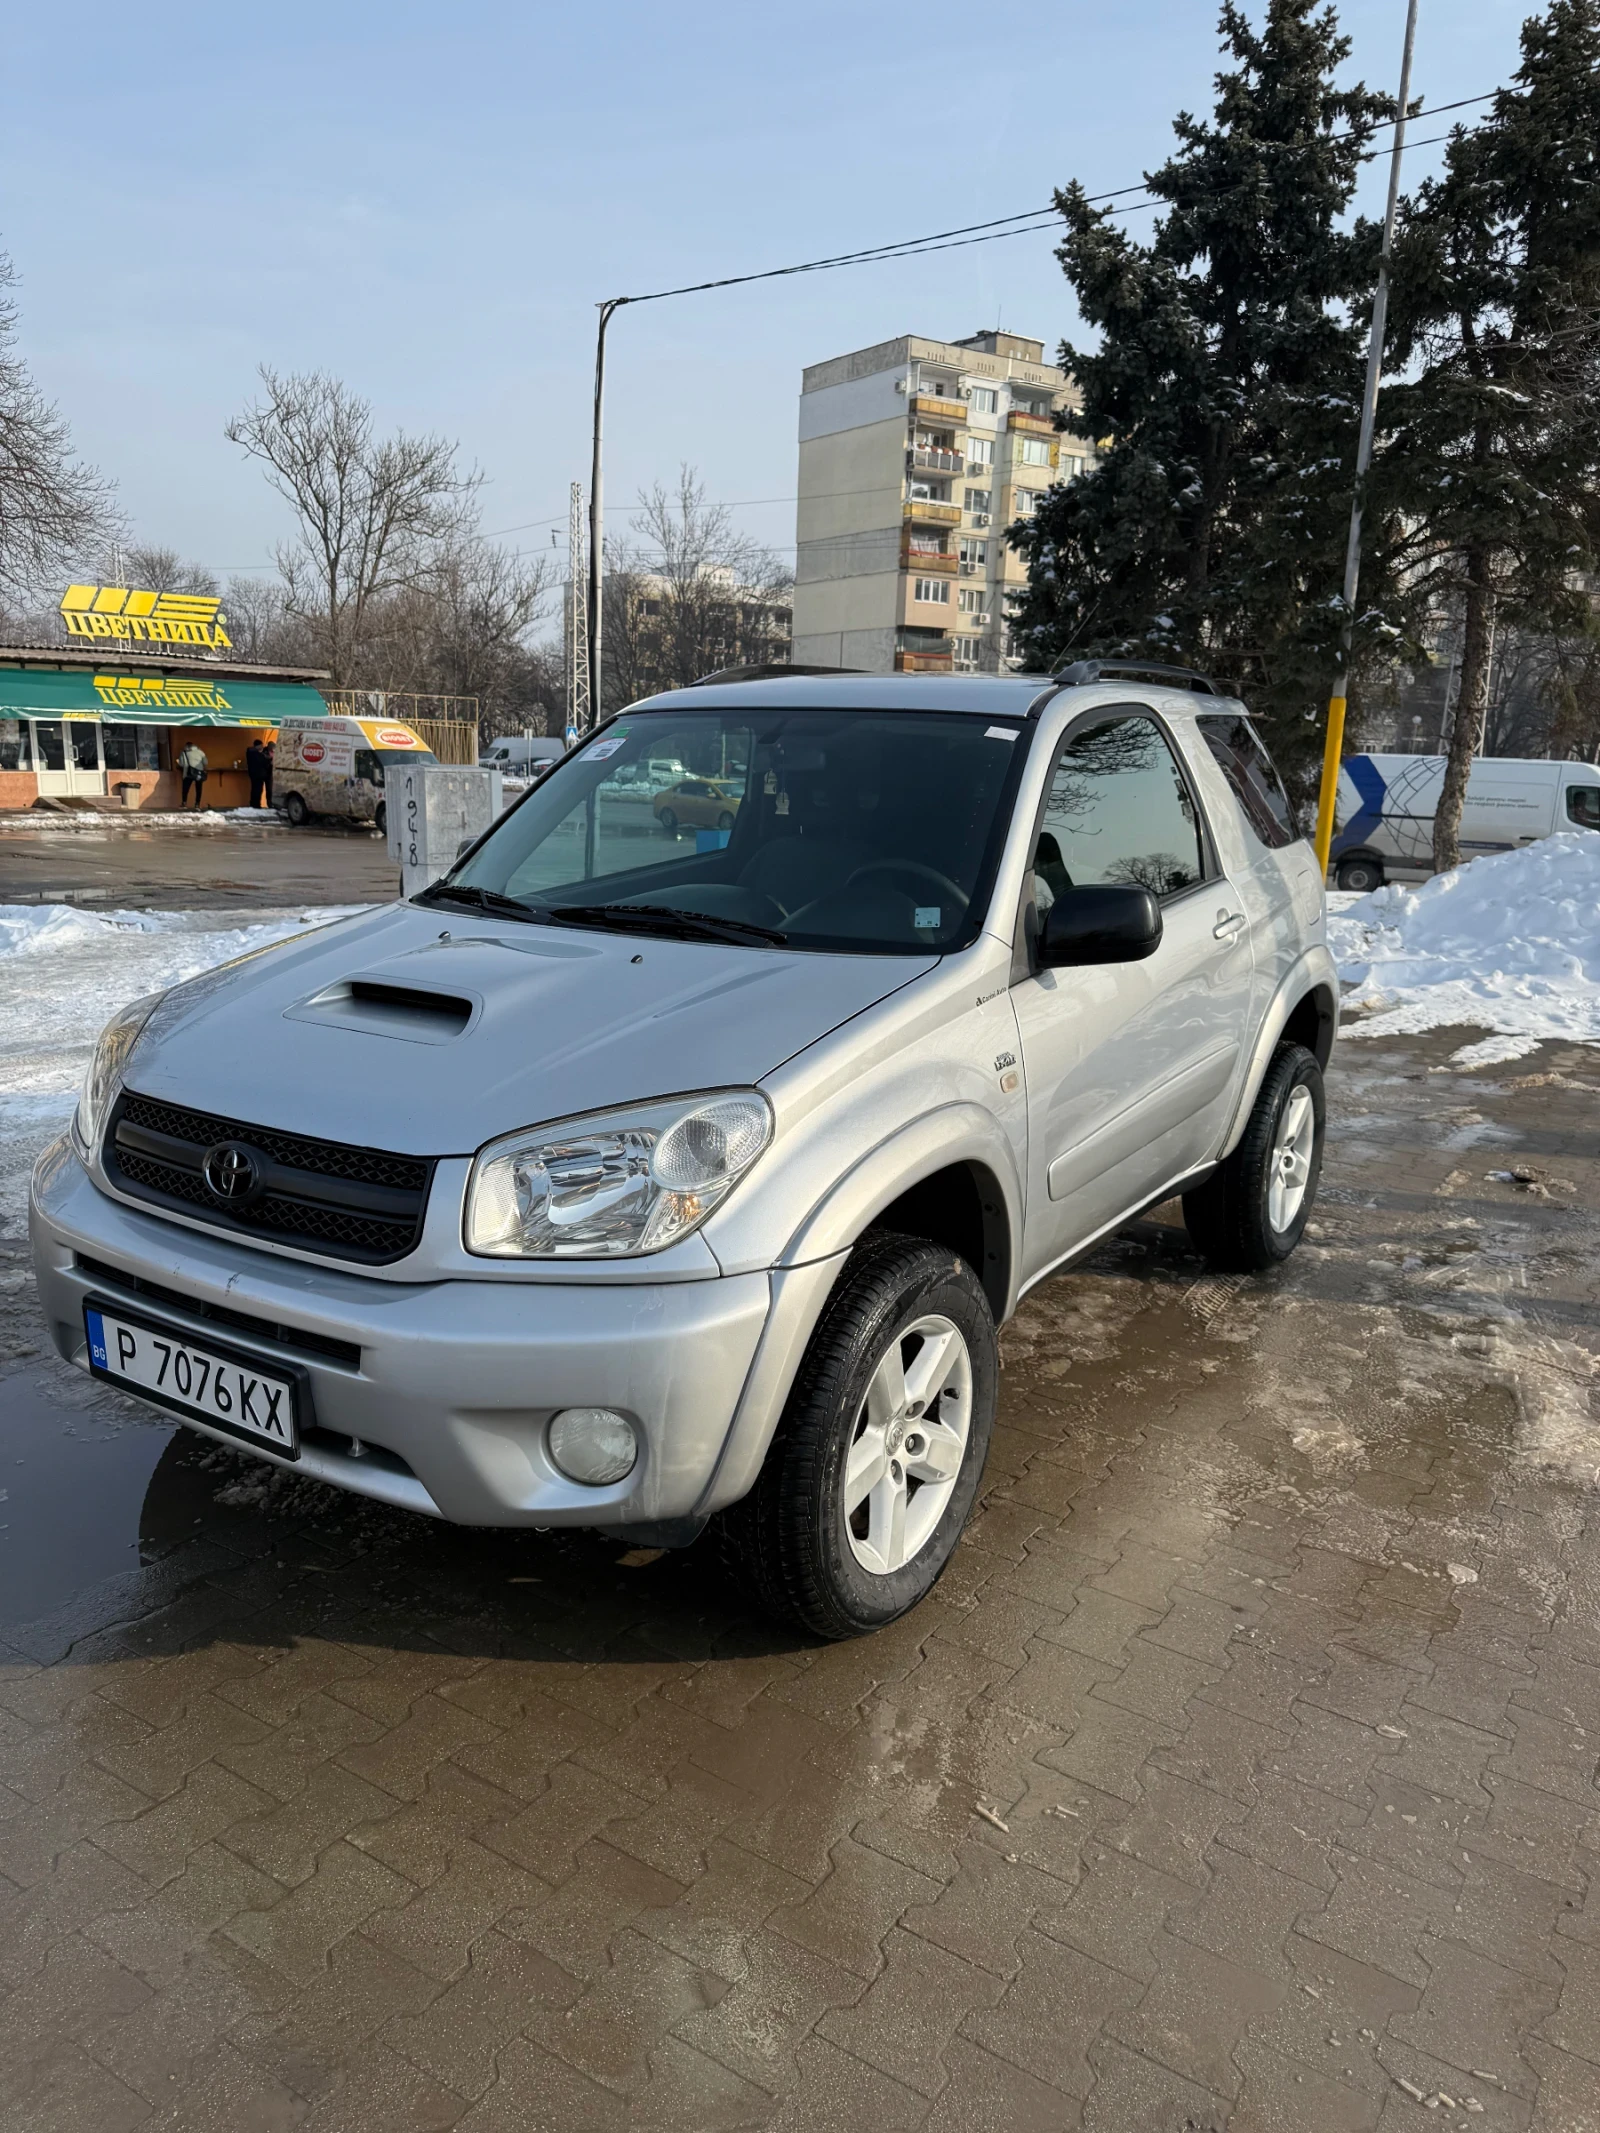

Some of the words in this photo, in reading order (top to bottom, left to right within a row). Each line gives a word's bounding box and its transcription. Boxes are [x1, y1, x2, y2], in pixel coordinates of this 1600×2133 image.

[61, 611, 233, 651] ЦВЕТНИЦА
[95, 687, 232, 711] ЦВЕТНИЦА
[382, 734, 412, 743] BIOSET
[303, 748, 324, 757] BIOSET
[93, 1345, 106, 1361] BG
[117, 1327, 137, 1371] P
